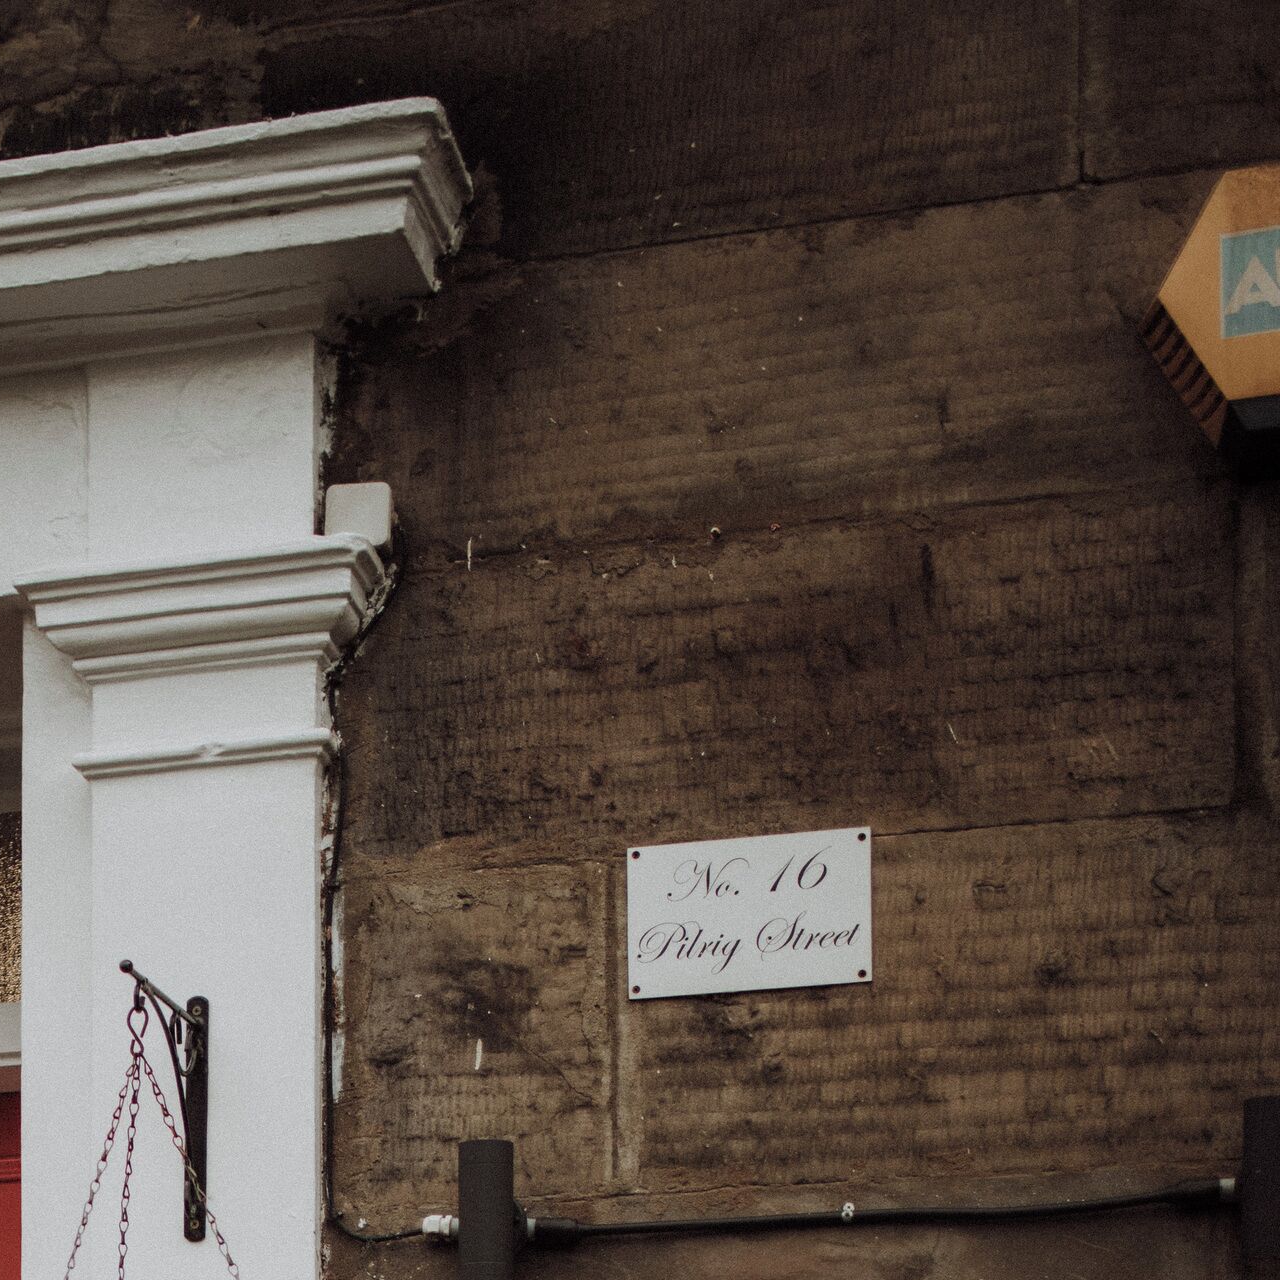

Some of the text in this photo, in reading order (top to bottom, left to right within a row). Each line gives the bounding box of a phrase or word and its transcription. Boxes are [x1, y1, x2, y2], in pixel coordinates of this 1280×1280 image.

[666, 846, 832, 902] No. 16
[637, 911, 861, 975] Pilrig Street
